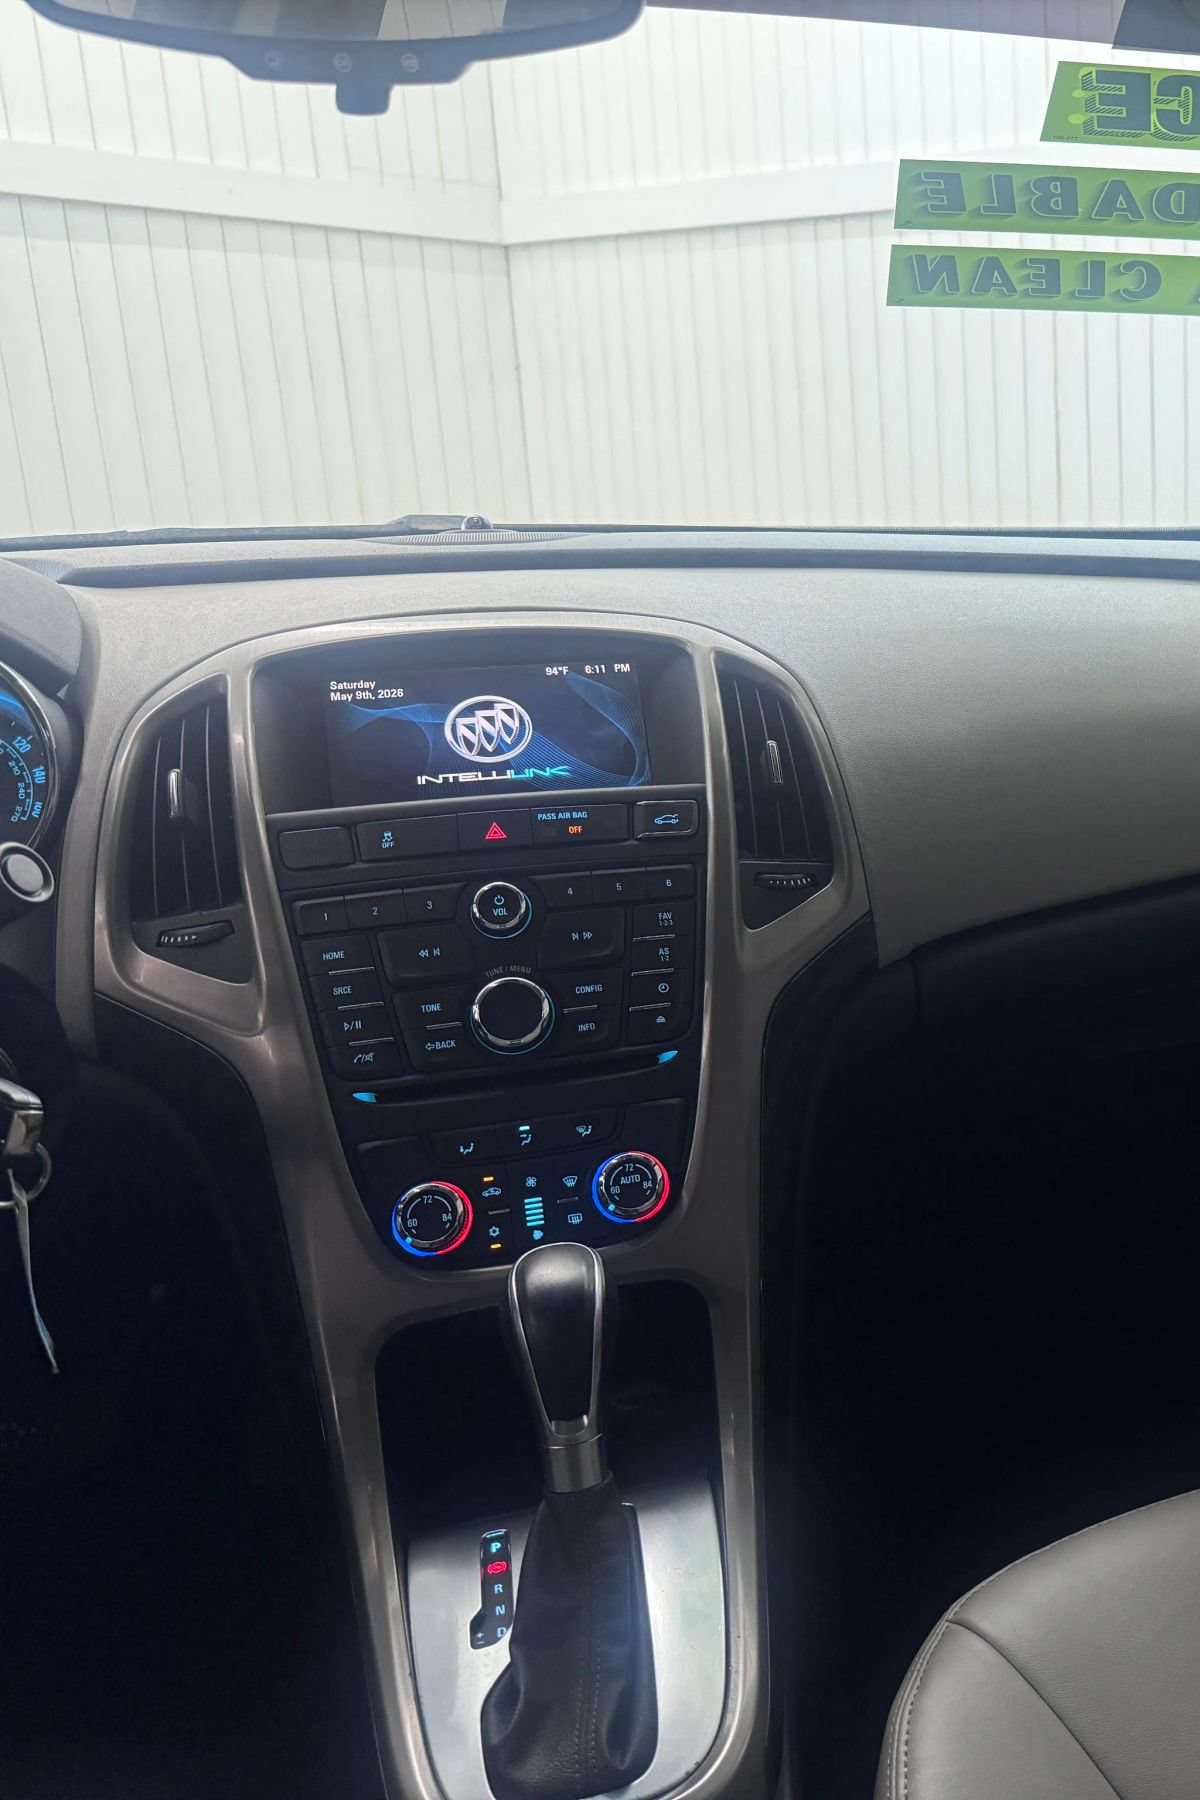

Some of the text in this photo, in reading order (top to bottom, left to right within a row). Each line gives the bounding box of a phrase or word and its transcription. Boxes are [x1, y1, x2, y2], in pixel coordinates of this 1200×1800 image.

[545, 663, 631, 676] 94°F 6:11 PM
[330, 679, 376, 692] Saturday
[330, 688, 404, 702] May 9th, 2026
[12, 735, 31, 753] 120
[8, 760, 21, 776] 210
[17, 782, 26, 800] 240
[11, 806, 23, 823] 270
[537, 811, 588, 821] PASS AIR BAG
[568, 825, 583, 834] OFF
[381, 841, 395, 849] OFF
[616, 883, 622, 891] 5
[666, 879, 672, 887] 6
[567, 887, 573, 896] 4
[427, 901, 433, 910] 3
[372, 907, 379, 915] 2
[493, 908, 508, 917] VOL
[658, 912, 672, 920] FAV
[322, 951, 345, 961] HOME
[659, 947, 670, 956] AS
[484, 966, 504, 978] TUNE
[510, 965, 532, 974] MENU
[333, 986, 352, 995] SRCE
[575, 985, 603, 994] CONFIG
[421, 1003, 442, 1013] TONE
[578, 1023, 595, 1032] INFO
[435, 1040, 456, 1050] BACK
[624, 1163, 634, 1172] 72
[620, 1174, 641, 1185] AUTO
[610, 1186, 621, 1195] 60
[423, 1195, 433, 1204] 72
[442, 1212, 452, 1223] 84
[407, 1218, 418, 1228] 60
[490, 1542, 501, 1552] P
[494, 1584, 503, 1593] R
[496, 1605, 505, 1615] N
[497, 1627, 507, 1637] D
